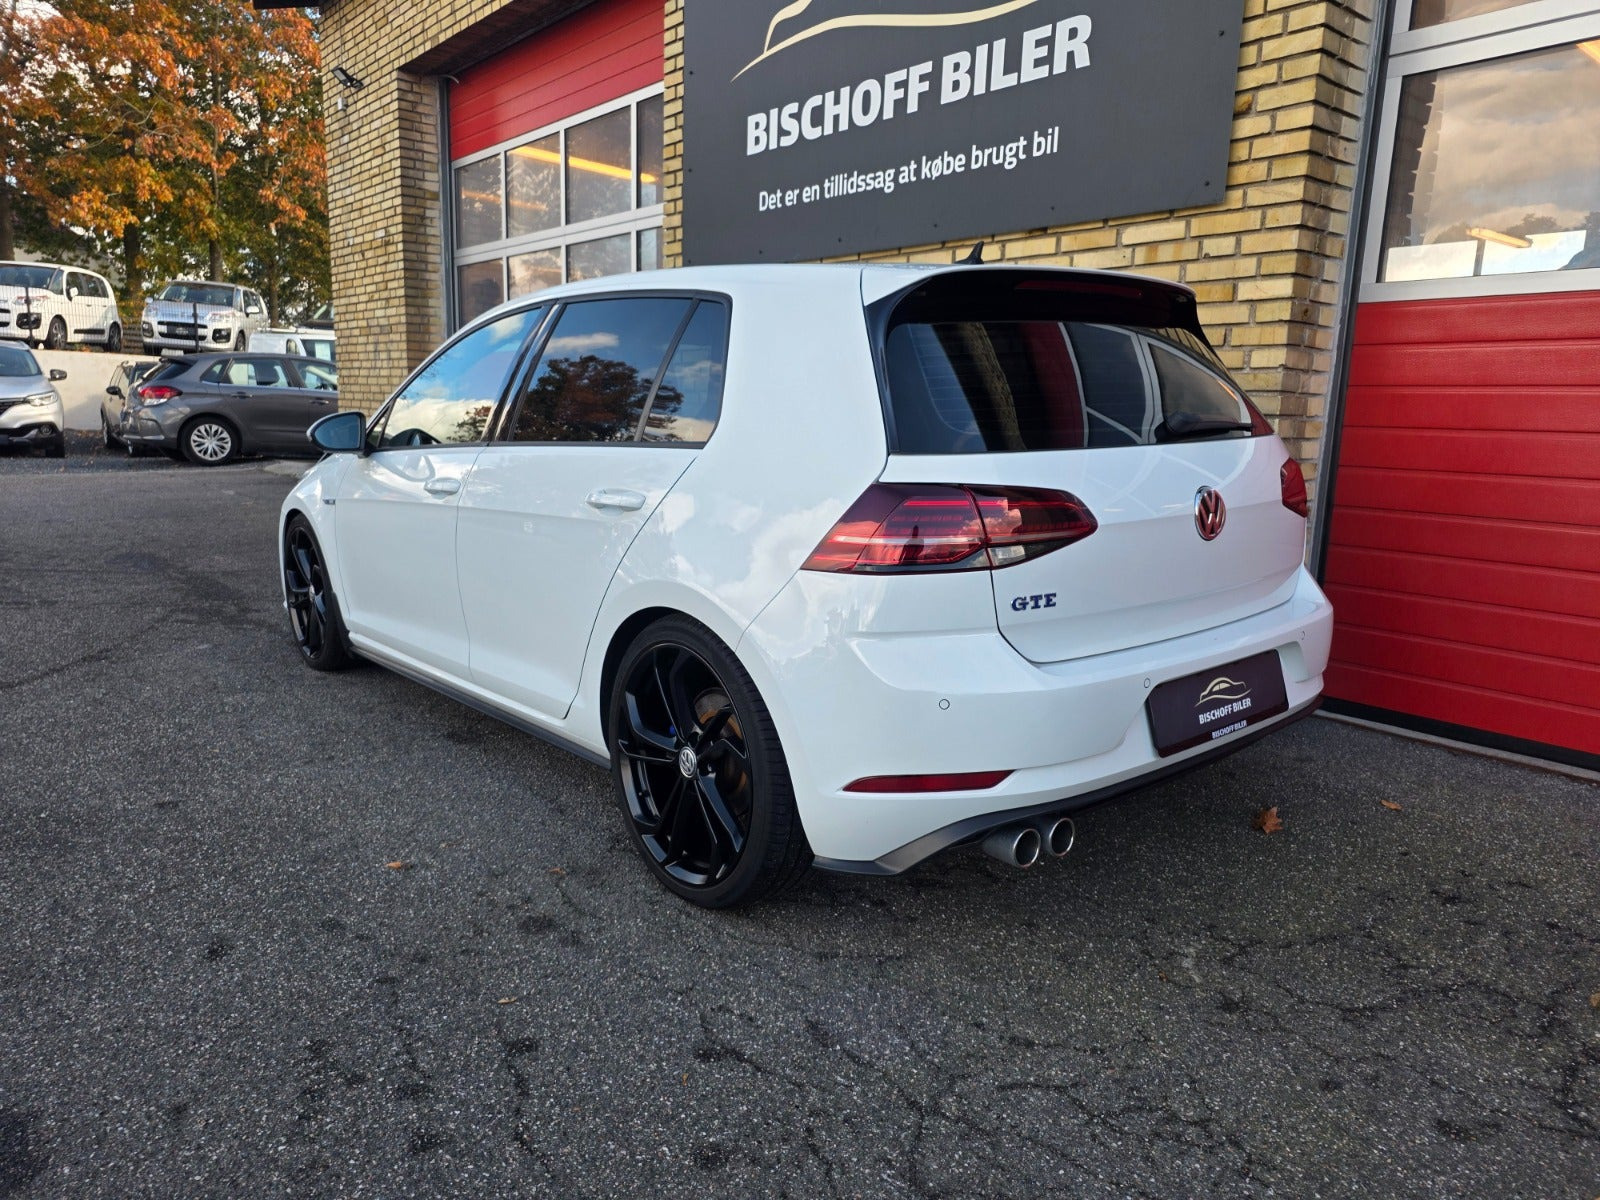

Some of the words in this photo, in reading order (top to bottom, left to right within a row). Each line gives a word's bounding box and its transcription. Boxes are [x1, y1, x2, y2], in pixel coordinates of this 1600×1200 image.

[746, 60, 933, 156] BISCHOFF
[940, 14, 1092, 105] BILER
[758, 188, 783, 212] Det
[784, 186, 800, 207] er
[802, 184, 820, 204] en
[823, 168, 896, 199] tillidssag
[898, 160, 918, 184] at
[920, 150, 966, 181] købe
[970, 133, 1028, 170] brugt
[1032, 126, 1060, 157] bil
[1011, 592, 1058, 612] GTE
[1198, 703, 1233, 725] BISCHOFF
[1232, 697, 1252, 713] BILER
